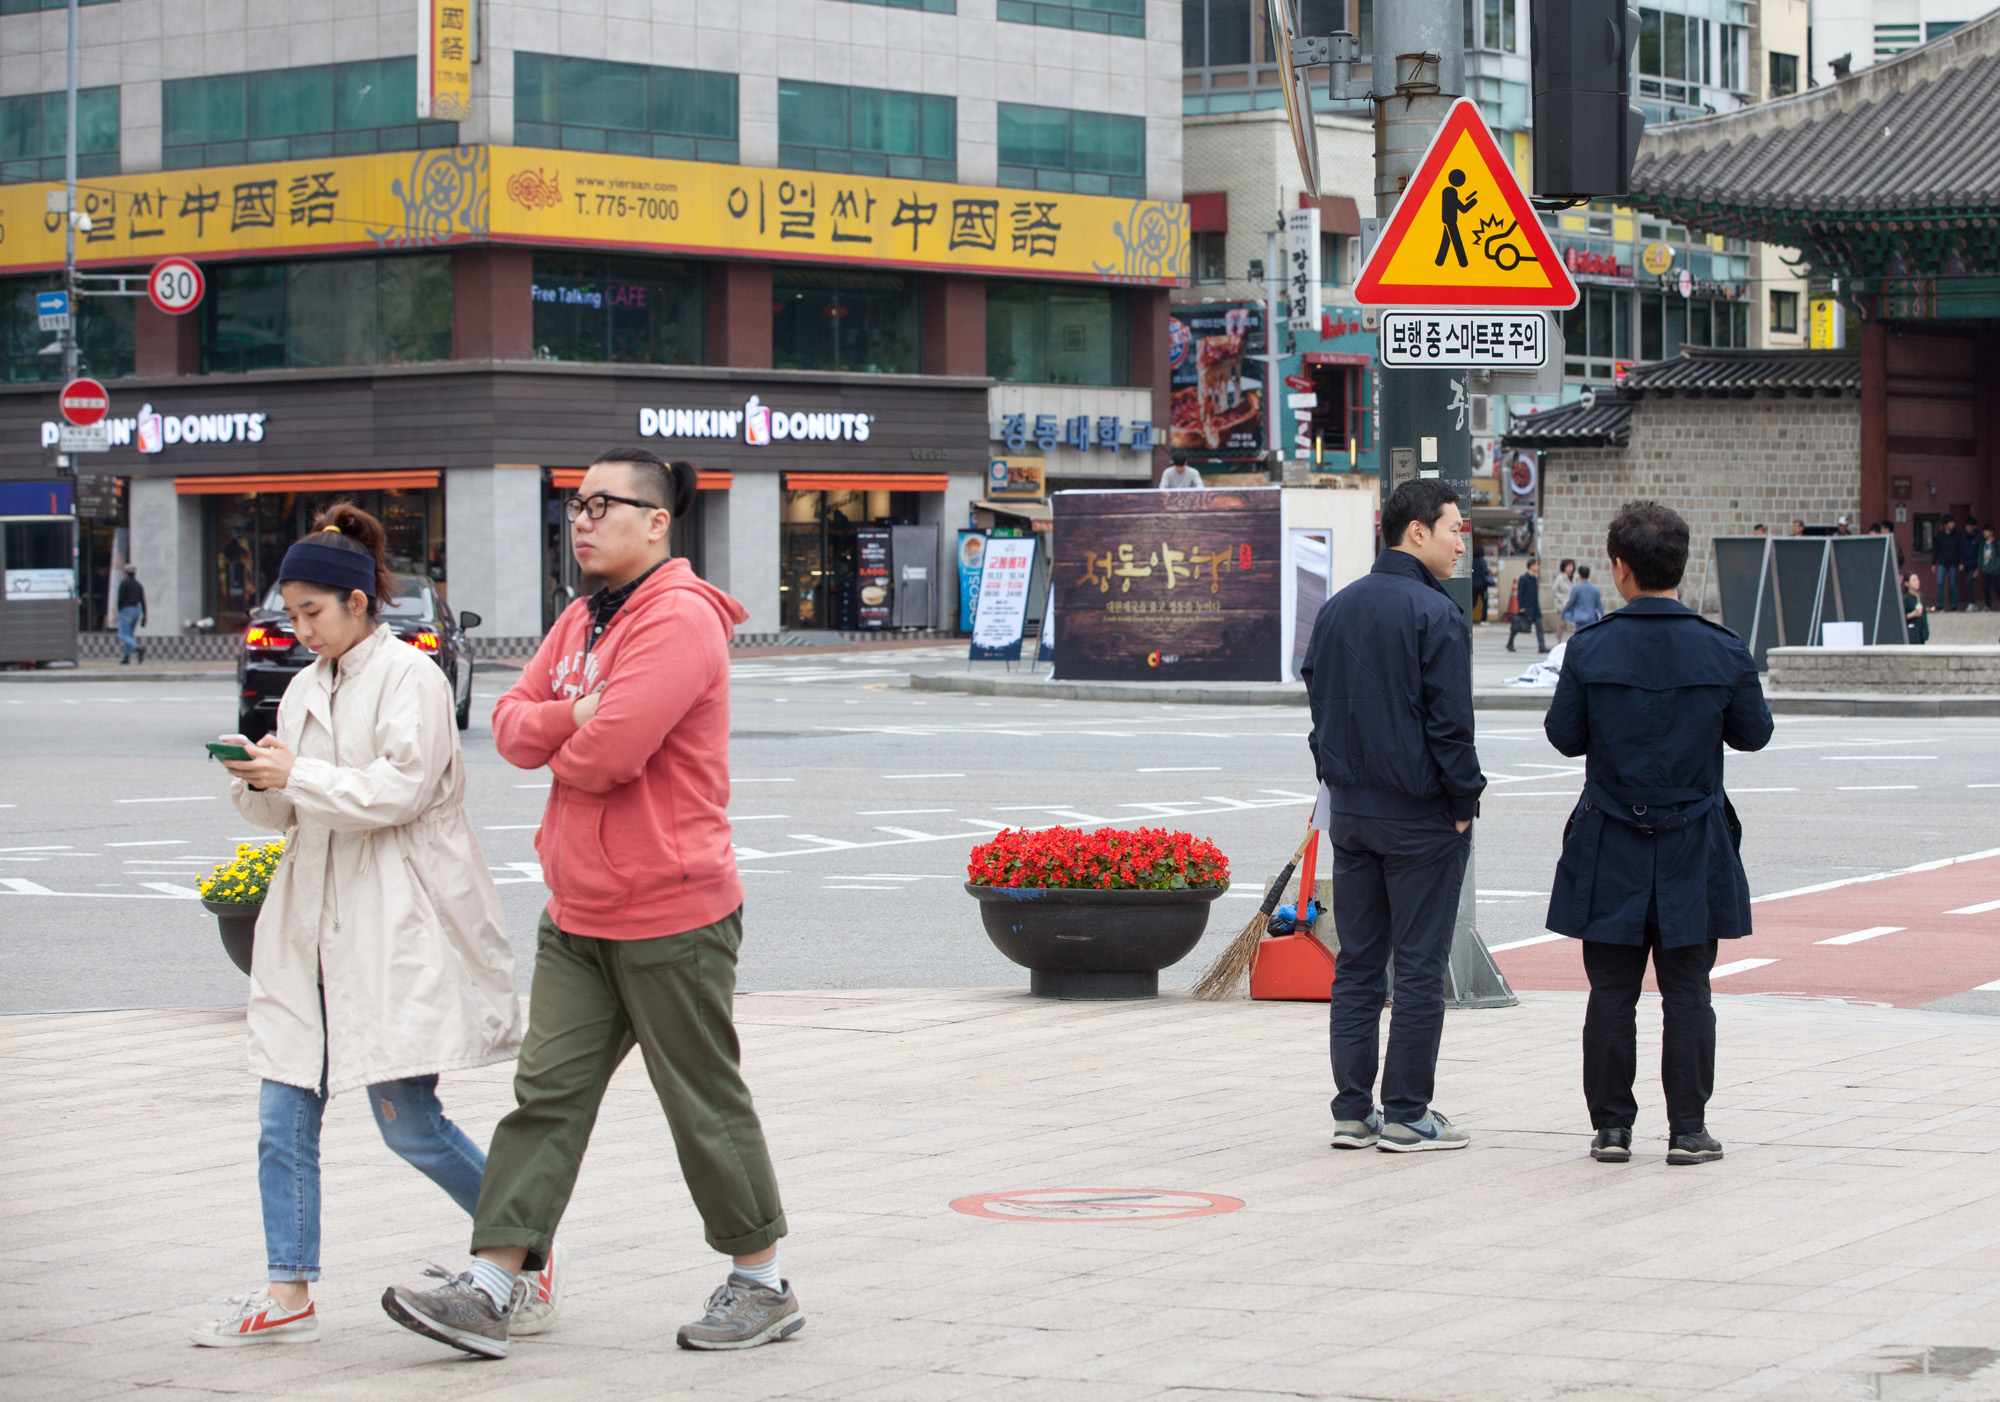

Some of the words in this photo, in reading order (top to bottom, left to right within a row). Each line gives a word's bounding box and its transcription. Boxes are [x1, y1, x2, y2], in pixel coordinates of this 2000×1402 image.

[160, 271, 192, 300] 30
[605, 285, 646, 307] CAFE
[1391, 320, 1422, 358] 보행
[1426, 321, 1441, 358] 중
[1445, 320, 1504, 359] 스마트폰
[1508, 320, 1538, 359] 주의
[163, 412, 264, 444] DONUTS
[640, 407, 743, 438] DUNKIN'
[772, 411, 870, 441] DONUTS
[1002, 412, 1155, 452] 경동대학교
